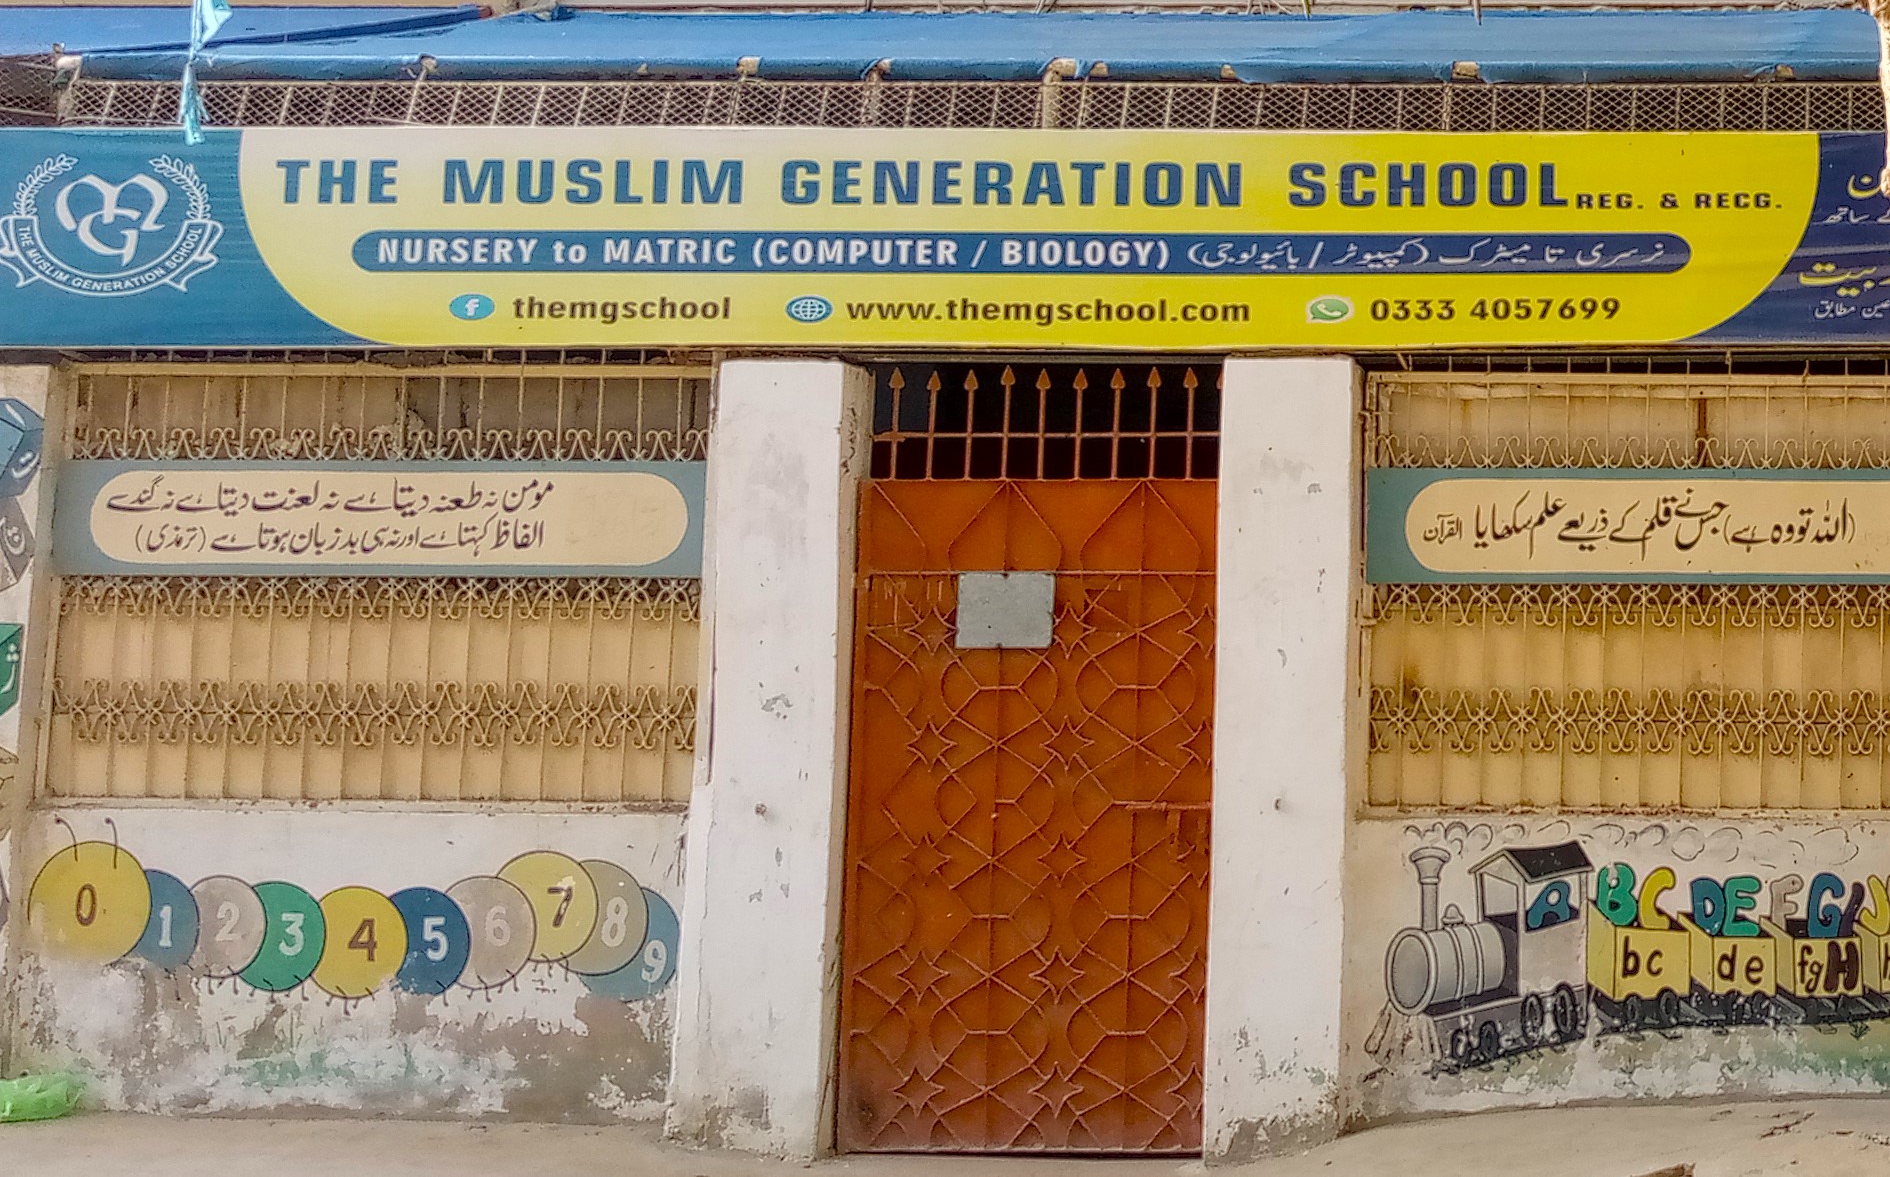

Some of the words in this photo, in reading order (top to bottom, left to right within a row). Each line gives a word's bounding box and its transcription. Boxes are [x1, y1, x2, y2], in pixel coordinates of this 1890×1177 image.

[276, 159, 398, 204] THE
[443, 159, 744, 205] MUSLIM
[781, 160, 1242, 207] GENERATION
[1289, 162, 1568, 208] SCHOOL
[1576, 193, 1644, 209] REG.
[1660, 193, 1680, 209] &
[1694, 193, 1783, 209] RECG.
[18, 226, 33, 248] THE
[26, 249, 71, 282] MUSLIM
[71, 267, 164, 291] GENERATION
[166, 228, 202, 270] SCHOOL
[377, 238, 538, 264] NURSERY
[553, 240, 587, 264] to
[603, 238, 736, 264] MATRIC
[752, 238, 958, 268] (COMPUTER
[1001, 238, 1171, 270] BIOLOGY)
[513, 296, 731, 323] themgschool
[847, 298, 1251, 325] www.themgschool.com
[1370, 298, 1456, 321] 0333
[1470, 297, 1622, 321] 4057699
[503, 479, 555, 513] مومن
[75, 884, 97, 926] 0
[157, 907, 172, 948] 1
[216, 902, 239, 941] 2
[279, 912, 305, 956] 3
[349, 918, 376, 961] 4
[423, 916, 449, 962] 5
[485, 906, 511, 948] 6
[600, 896, 628, 945] 8
[642, 938, 667, 983] 9
